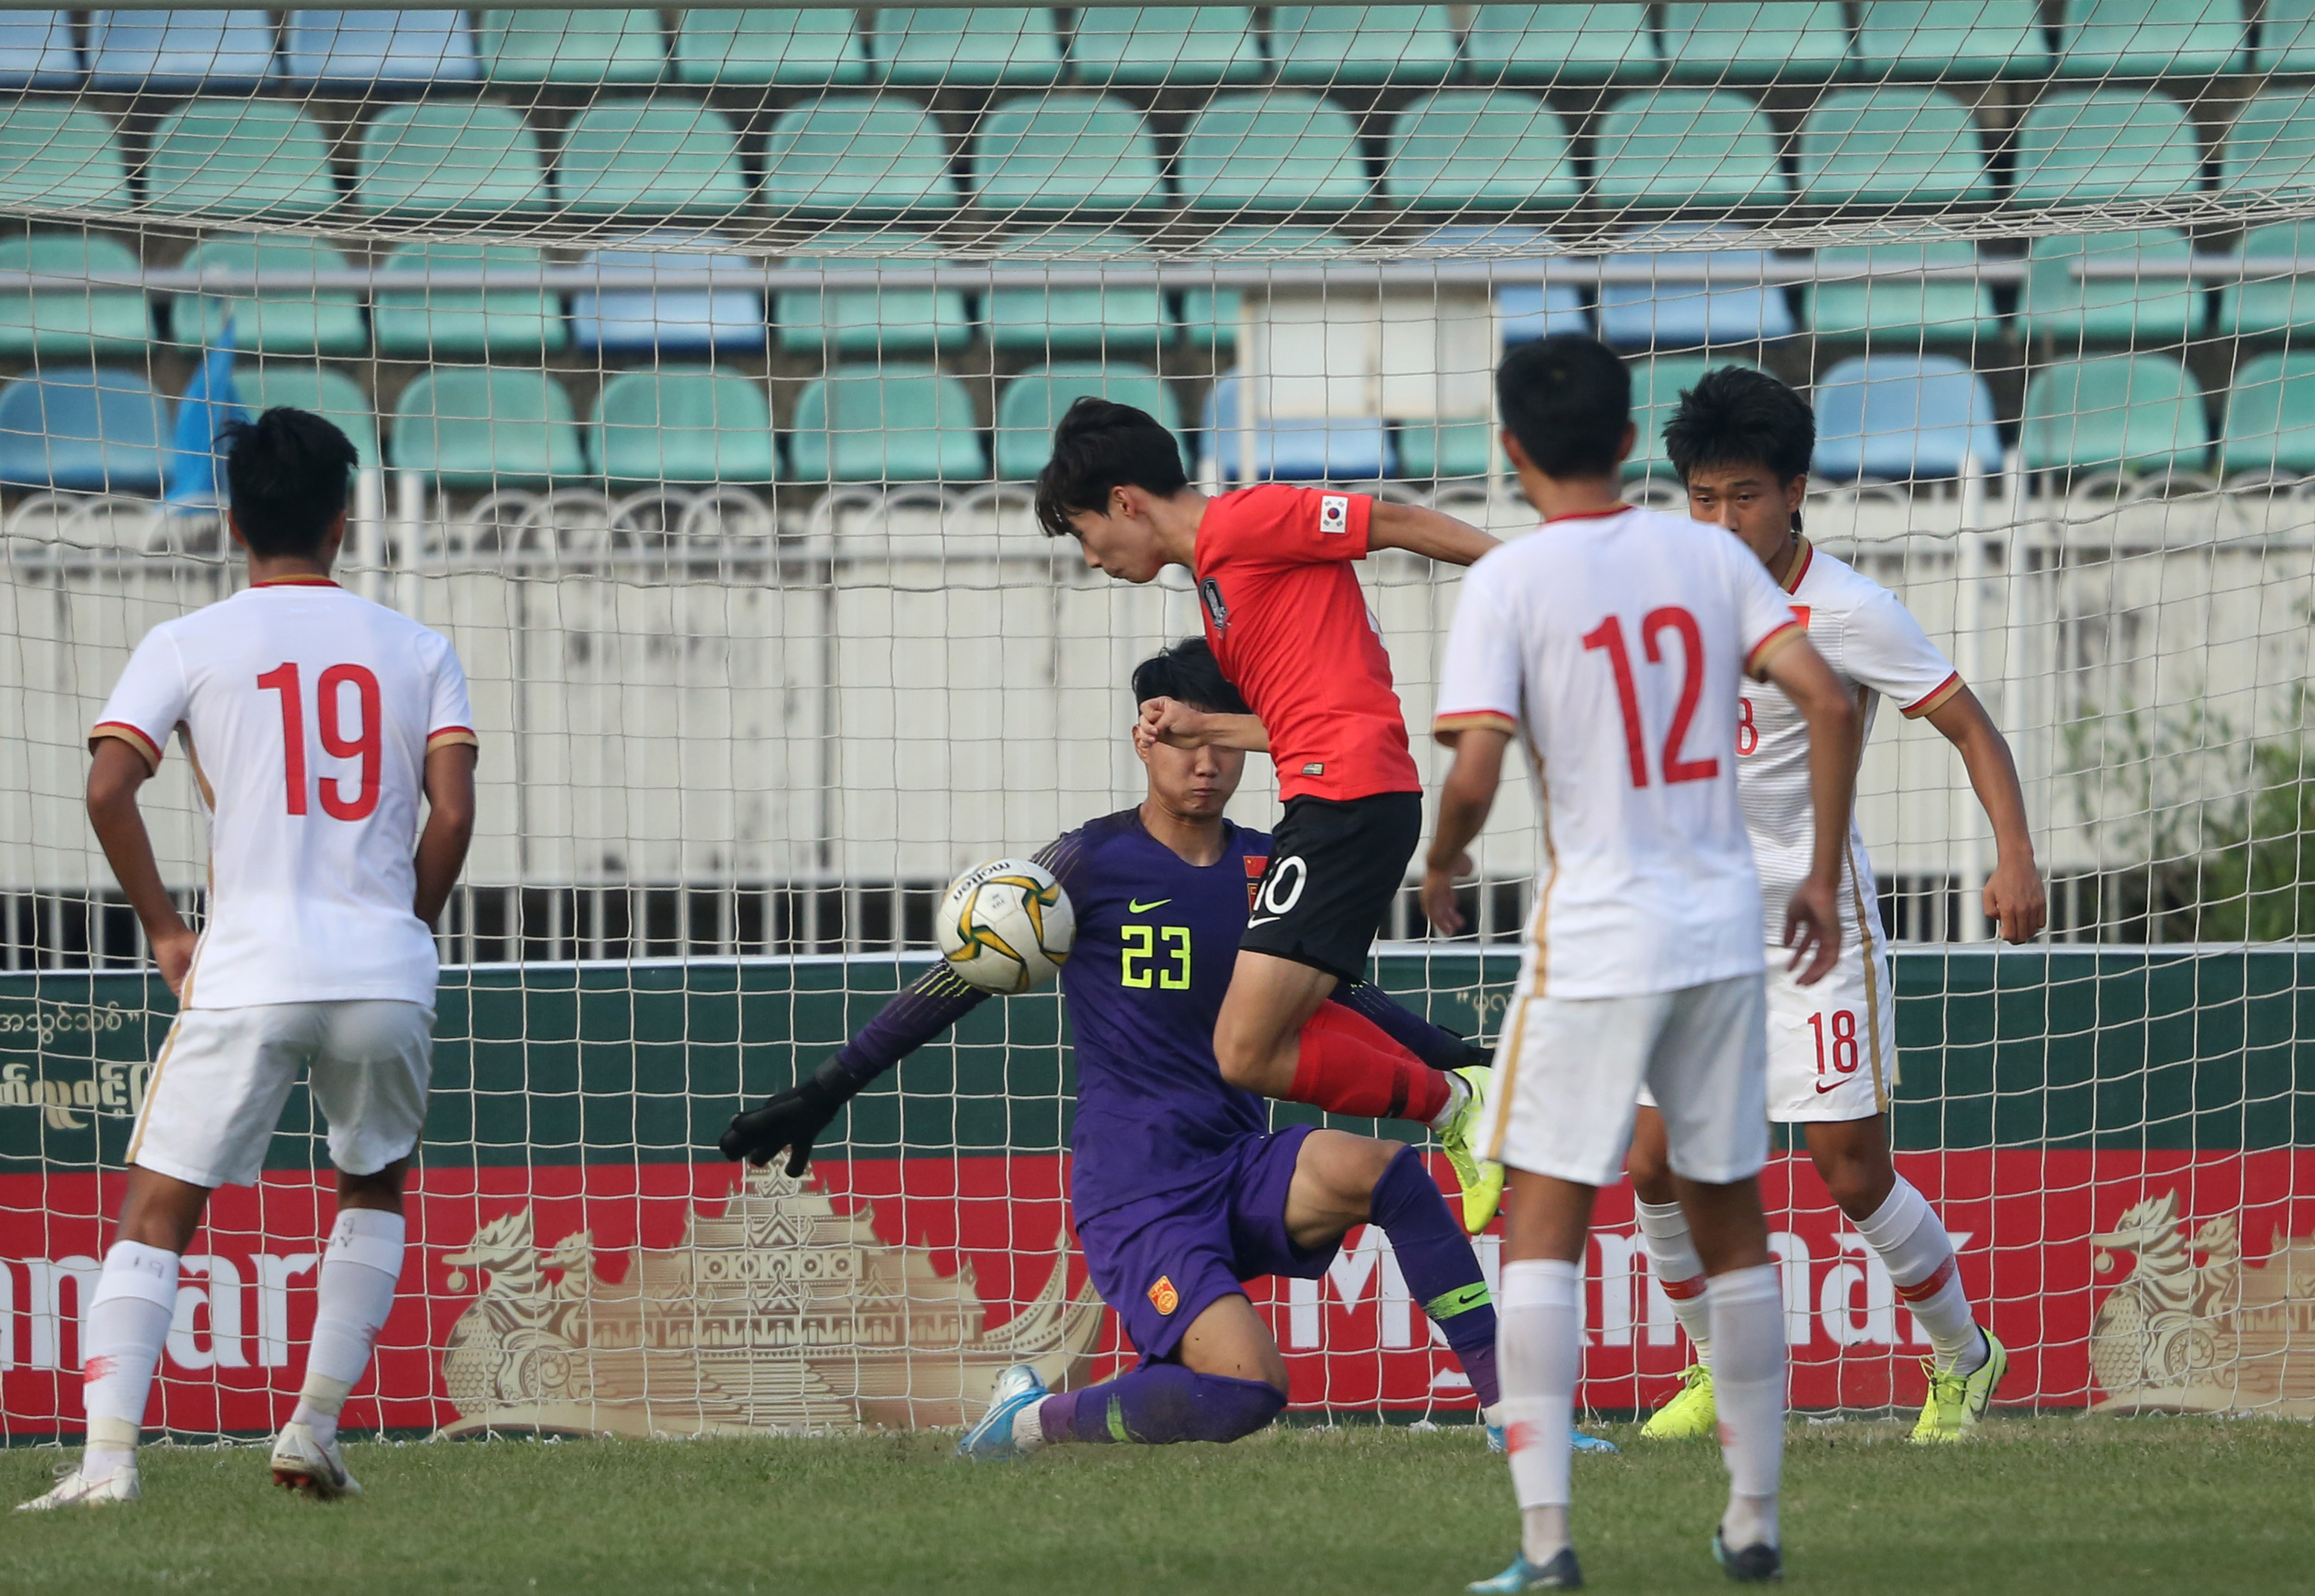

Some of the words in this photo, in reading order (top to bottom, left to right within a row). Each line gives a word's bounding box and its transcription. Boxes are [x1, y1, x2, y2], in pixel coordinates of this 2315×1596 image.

[1583, 607, 1718, 787] 12
[257, 663, 381, 821] 19
[953, 862, 1011, 900] molten
[1121, 925, 1192, 990] 23
[1808, 1010, 1858, 1075] 18
[134, 1255, 164, 1279] 19
